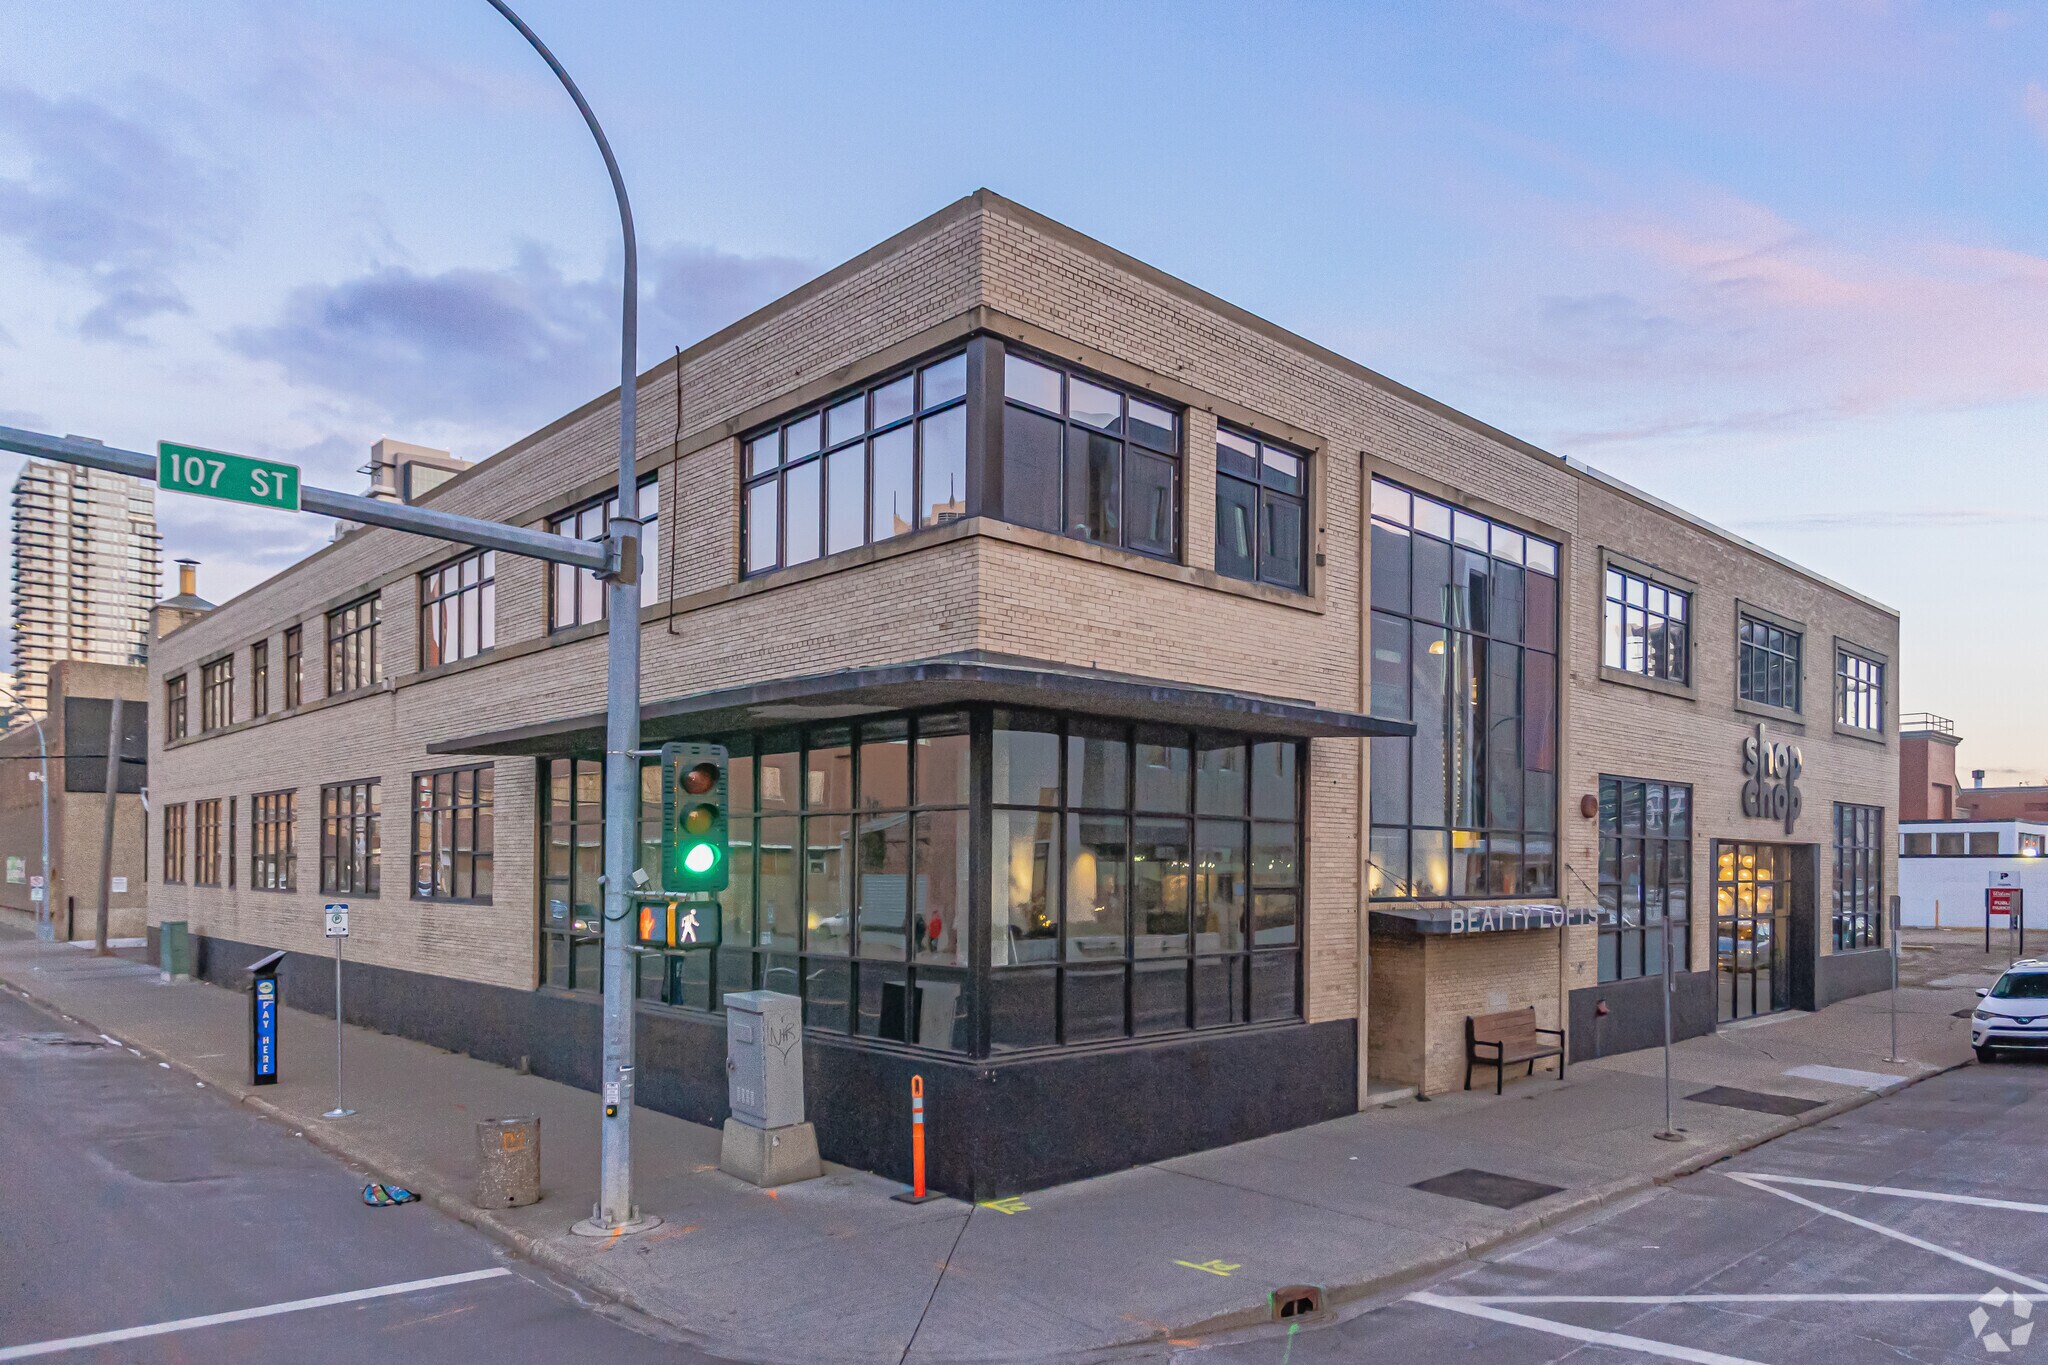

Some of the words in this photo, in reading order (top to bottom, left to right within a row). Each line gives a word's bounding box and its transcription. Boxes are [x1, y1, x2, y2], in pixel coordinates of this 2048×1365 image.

[171, 454, 226, 488] 107
[250, 468, 288, 500] ST
[1743, 722, 1802, 780] shop
[1742, 779, 1802, 834] chop
[1450, 905, 1532, 934] BEATTY
[1540, 904, 1598, 929] LOFTS
[262, 1001, 270, 1029] PAY
[262, 1036, 270, 1073] HERE
